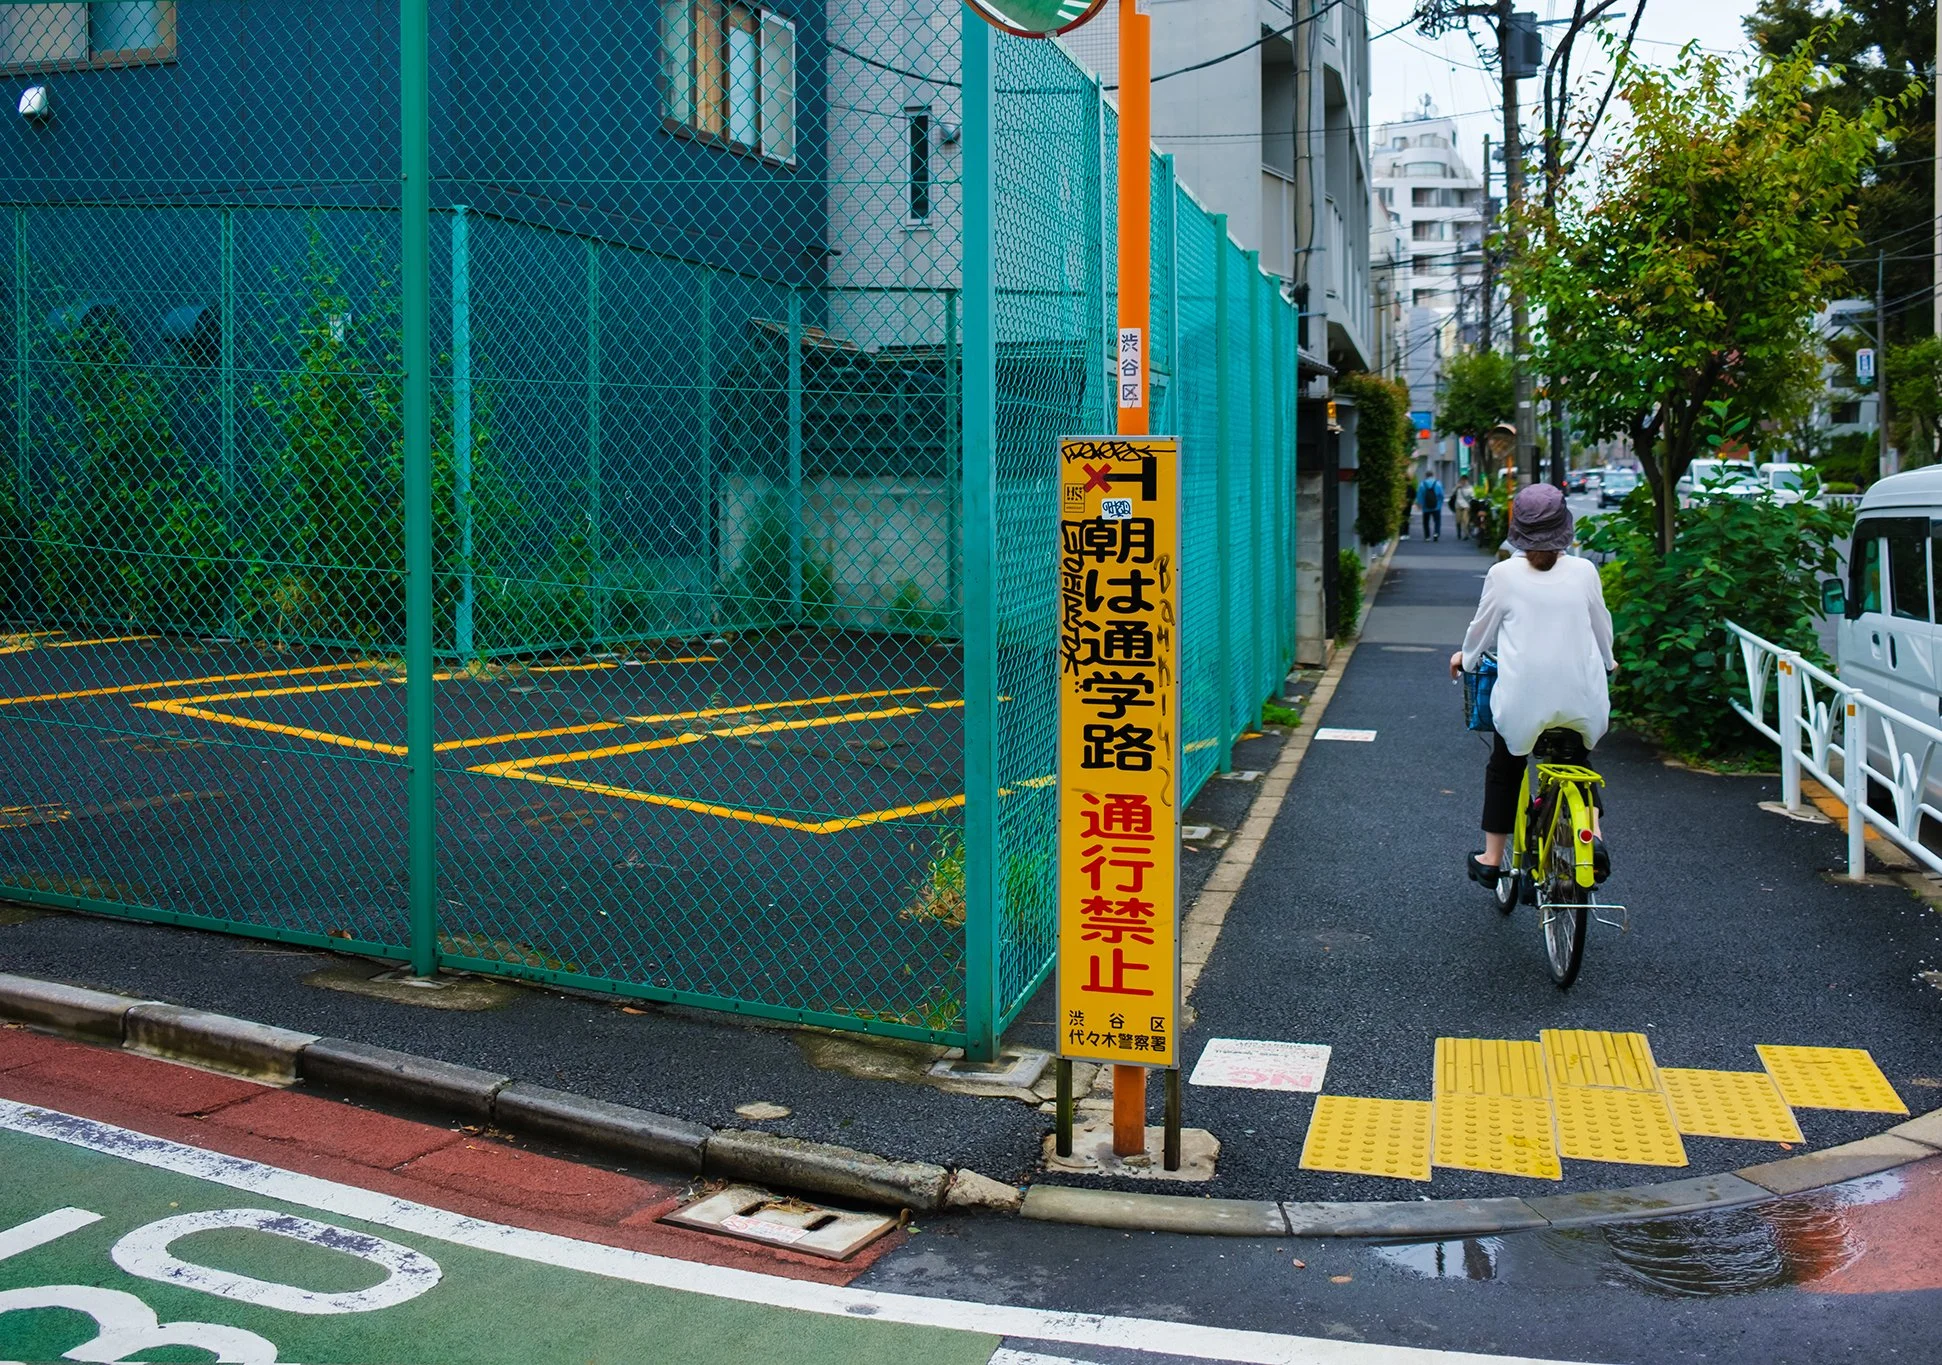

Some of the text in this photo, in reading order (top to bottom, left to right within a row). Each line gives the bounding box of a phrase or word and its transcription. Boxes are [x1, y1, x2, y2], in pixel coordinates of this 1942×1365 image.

[1121, 333, 1139, 401] 渋谷区
[1080, 516, 1157, 772] 朝は通学路
[1080, 793, 1156, 997] 通行禁止
[1068, 1009, 1166, 1033] 渋谷区
[1068, 1028, 1167, 1052] 代々木警察署
